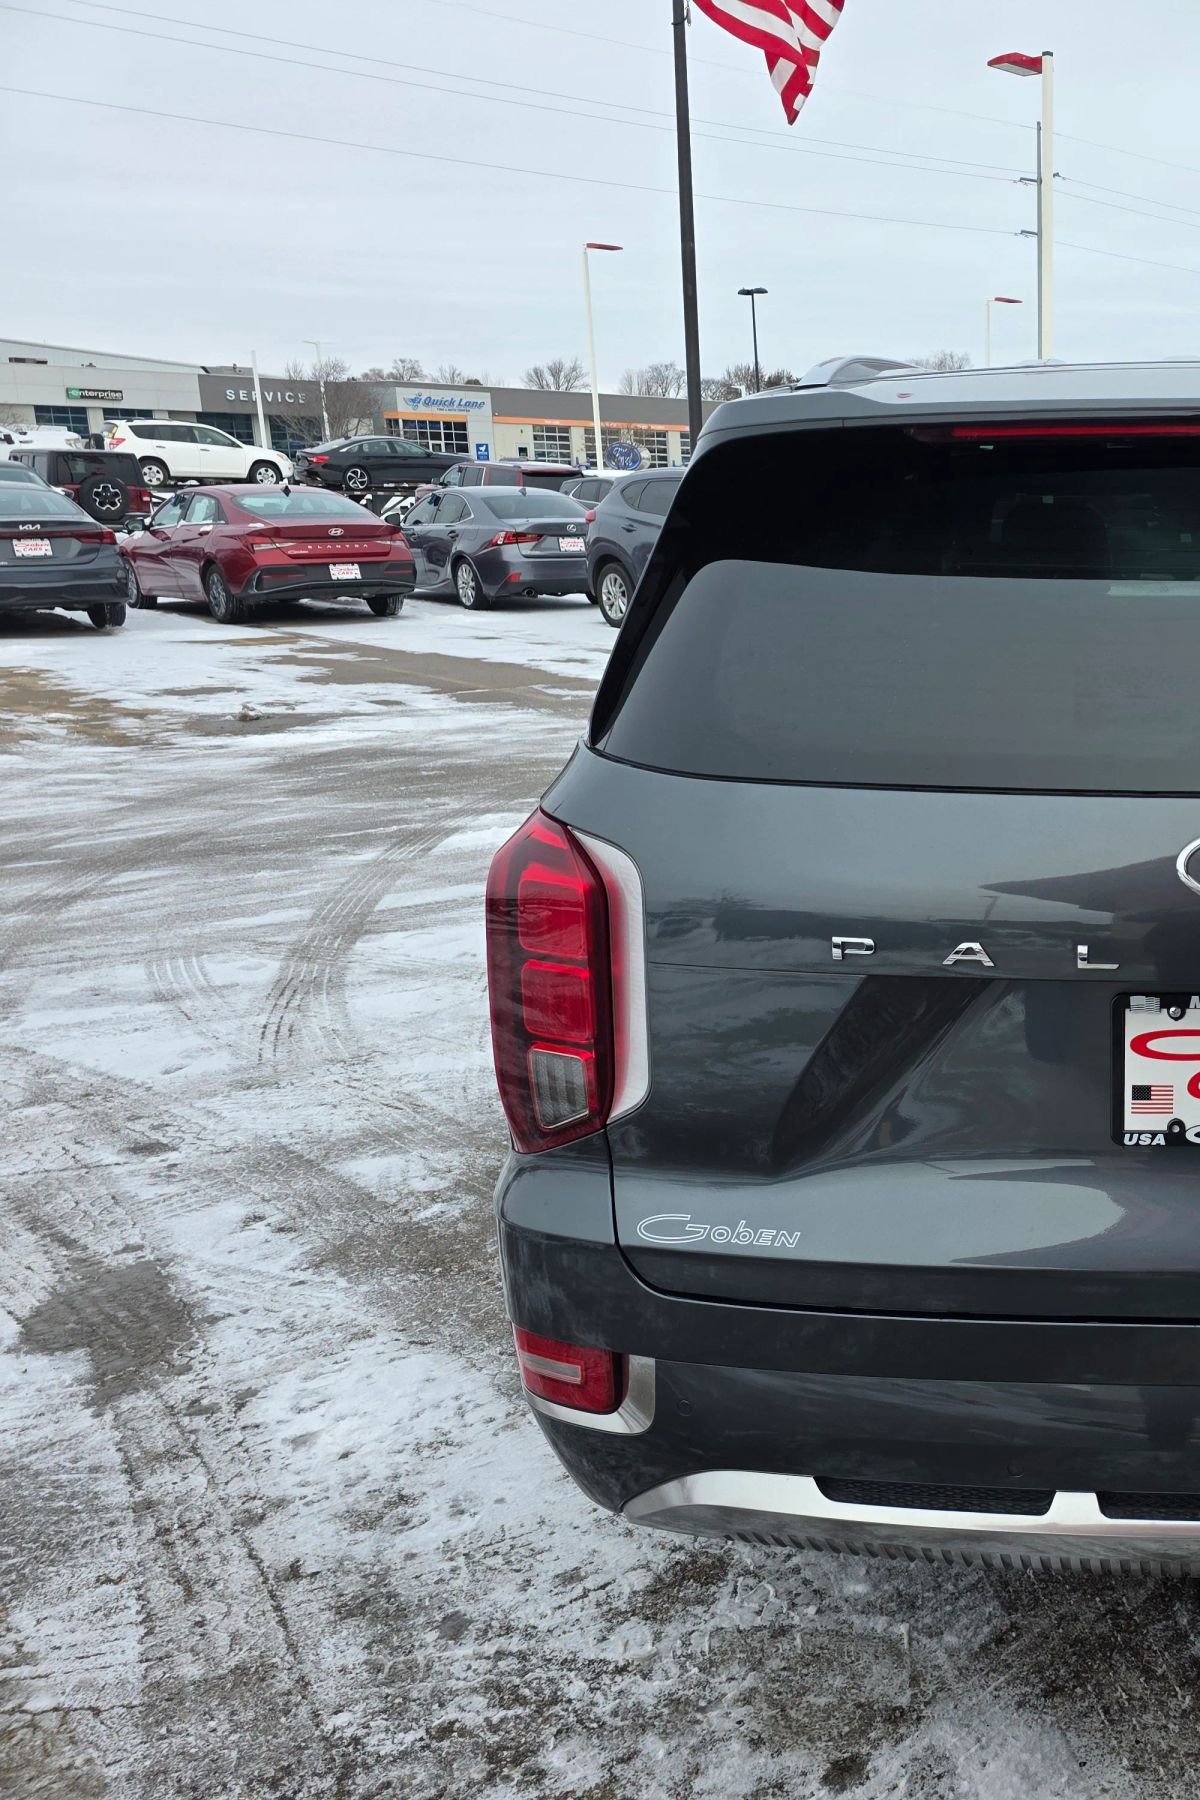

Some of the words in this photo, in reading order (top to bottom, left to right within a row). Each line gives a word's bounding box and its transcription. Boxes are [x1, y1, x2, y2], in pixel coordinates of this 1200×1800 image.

[69, 388, 122, 398] enterprise
[423, 396, 457, 408] Quick
[458, 398, 486, 409] Lane
[1123, 1133, 1166, 1146] USA
